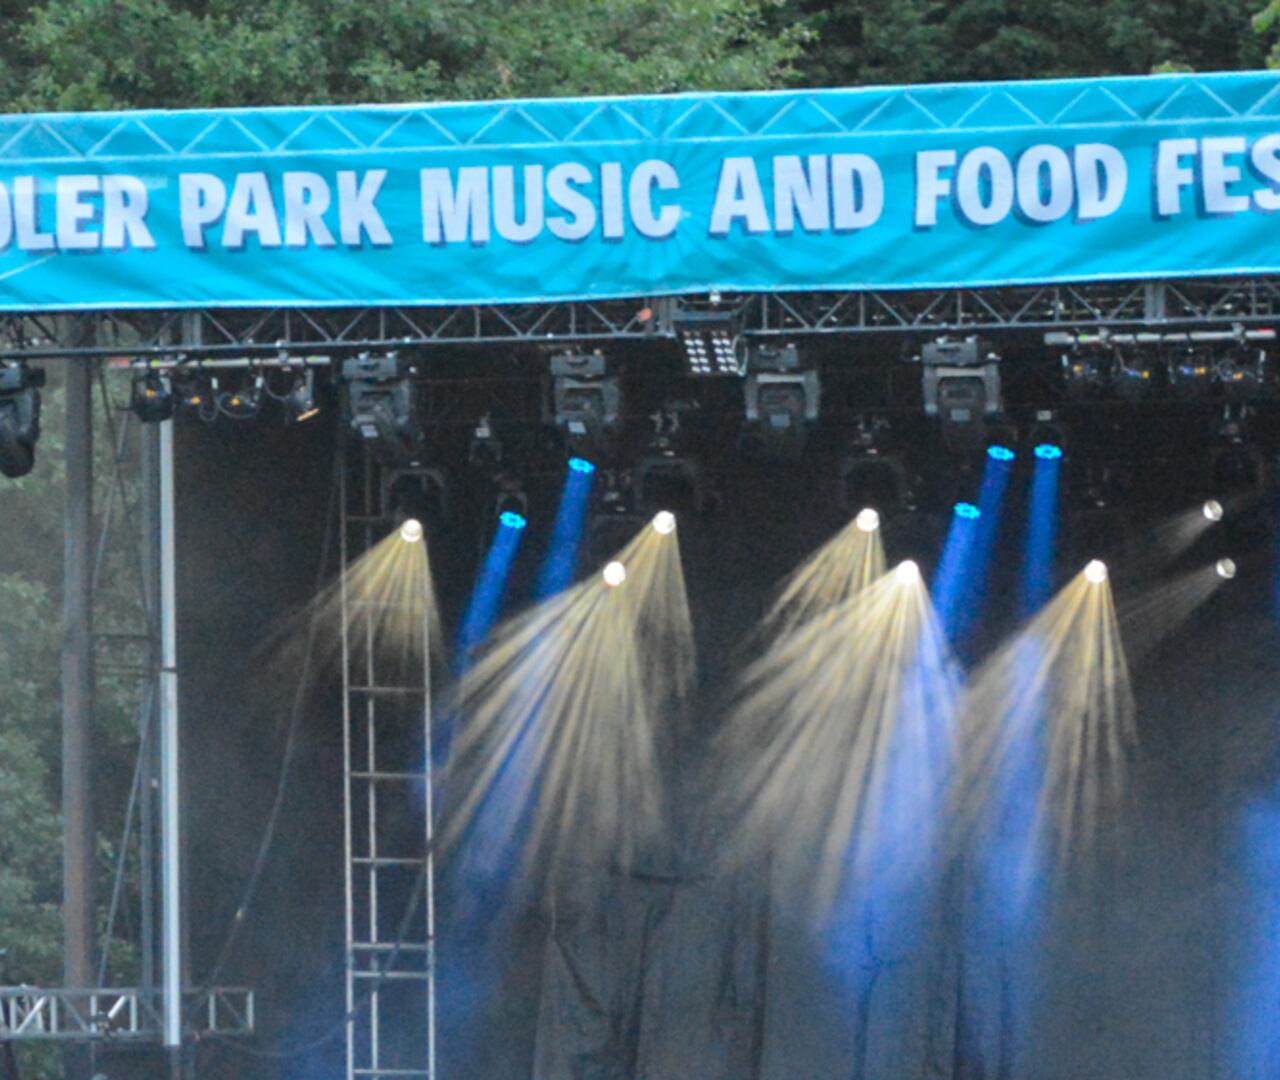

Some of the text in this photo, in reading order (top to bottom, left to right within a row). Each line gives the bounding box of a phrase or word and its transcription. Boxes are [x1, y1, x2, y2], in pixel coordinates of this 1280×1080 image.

[178, 168, 393, 249] PARK
[420, 159, 683, 244] MUSIC
[707, 153, 884, 239] AND
[914, 143, 1129, 229] FOOD
